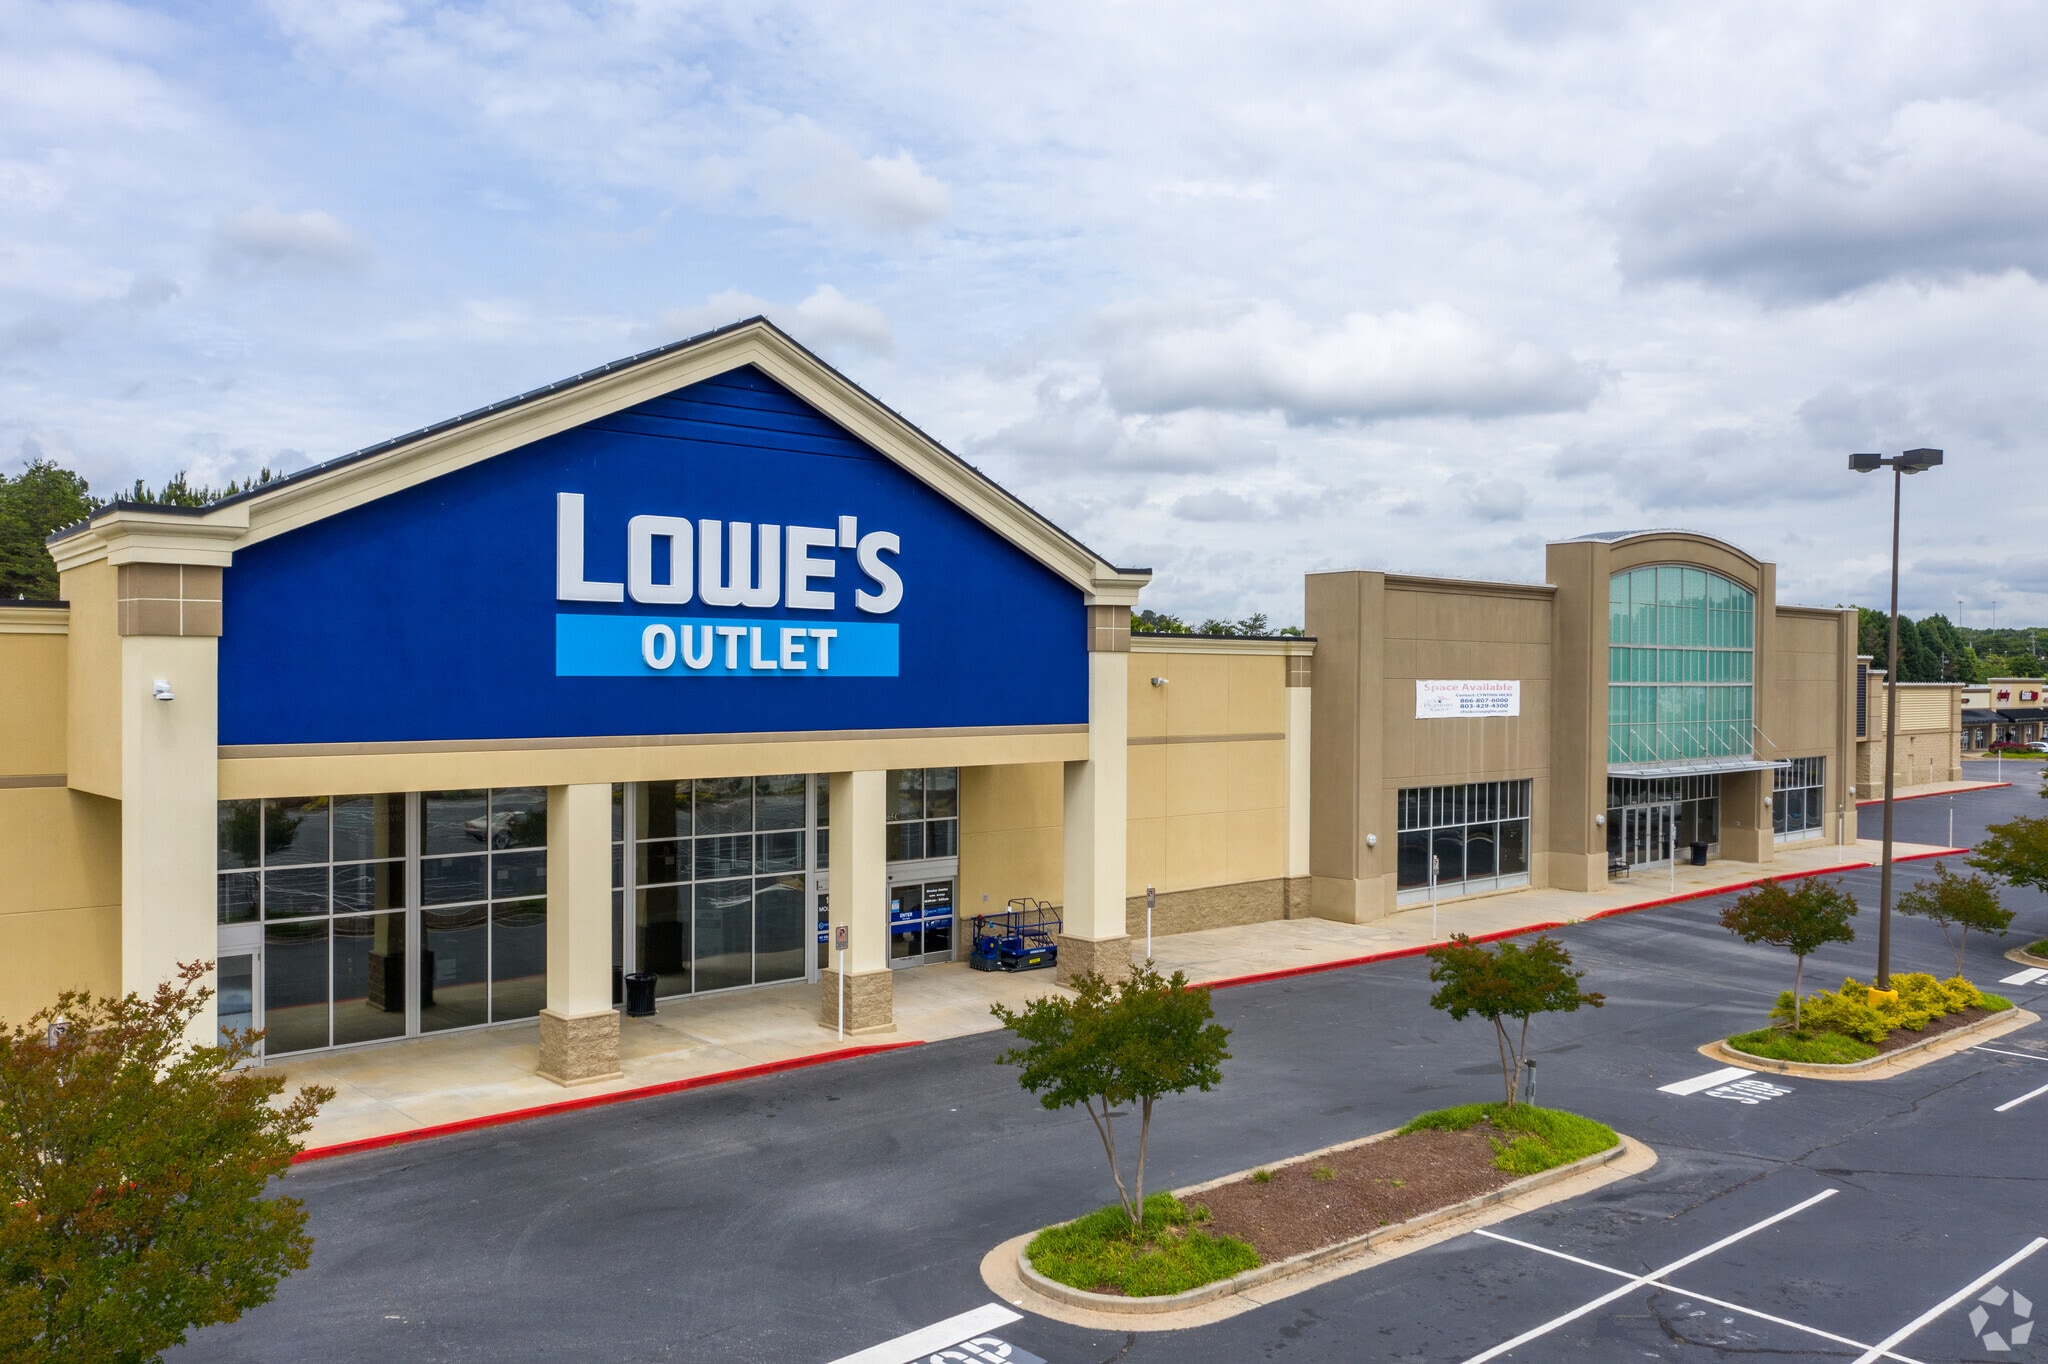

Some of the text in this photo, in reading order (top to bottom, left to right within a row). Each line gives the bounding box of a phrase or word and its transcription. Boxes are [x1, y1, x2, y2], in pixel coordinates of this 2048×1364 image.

[556, 491, 904, 614] LOWE'S
[641, 623, 838, 670] OUTLET
[1424, 683, 1513, 692] Space Available
[1705, 1079, 1793, 1105] STOP
